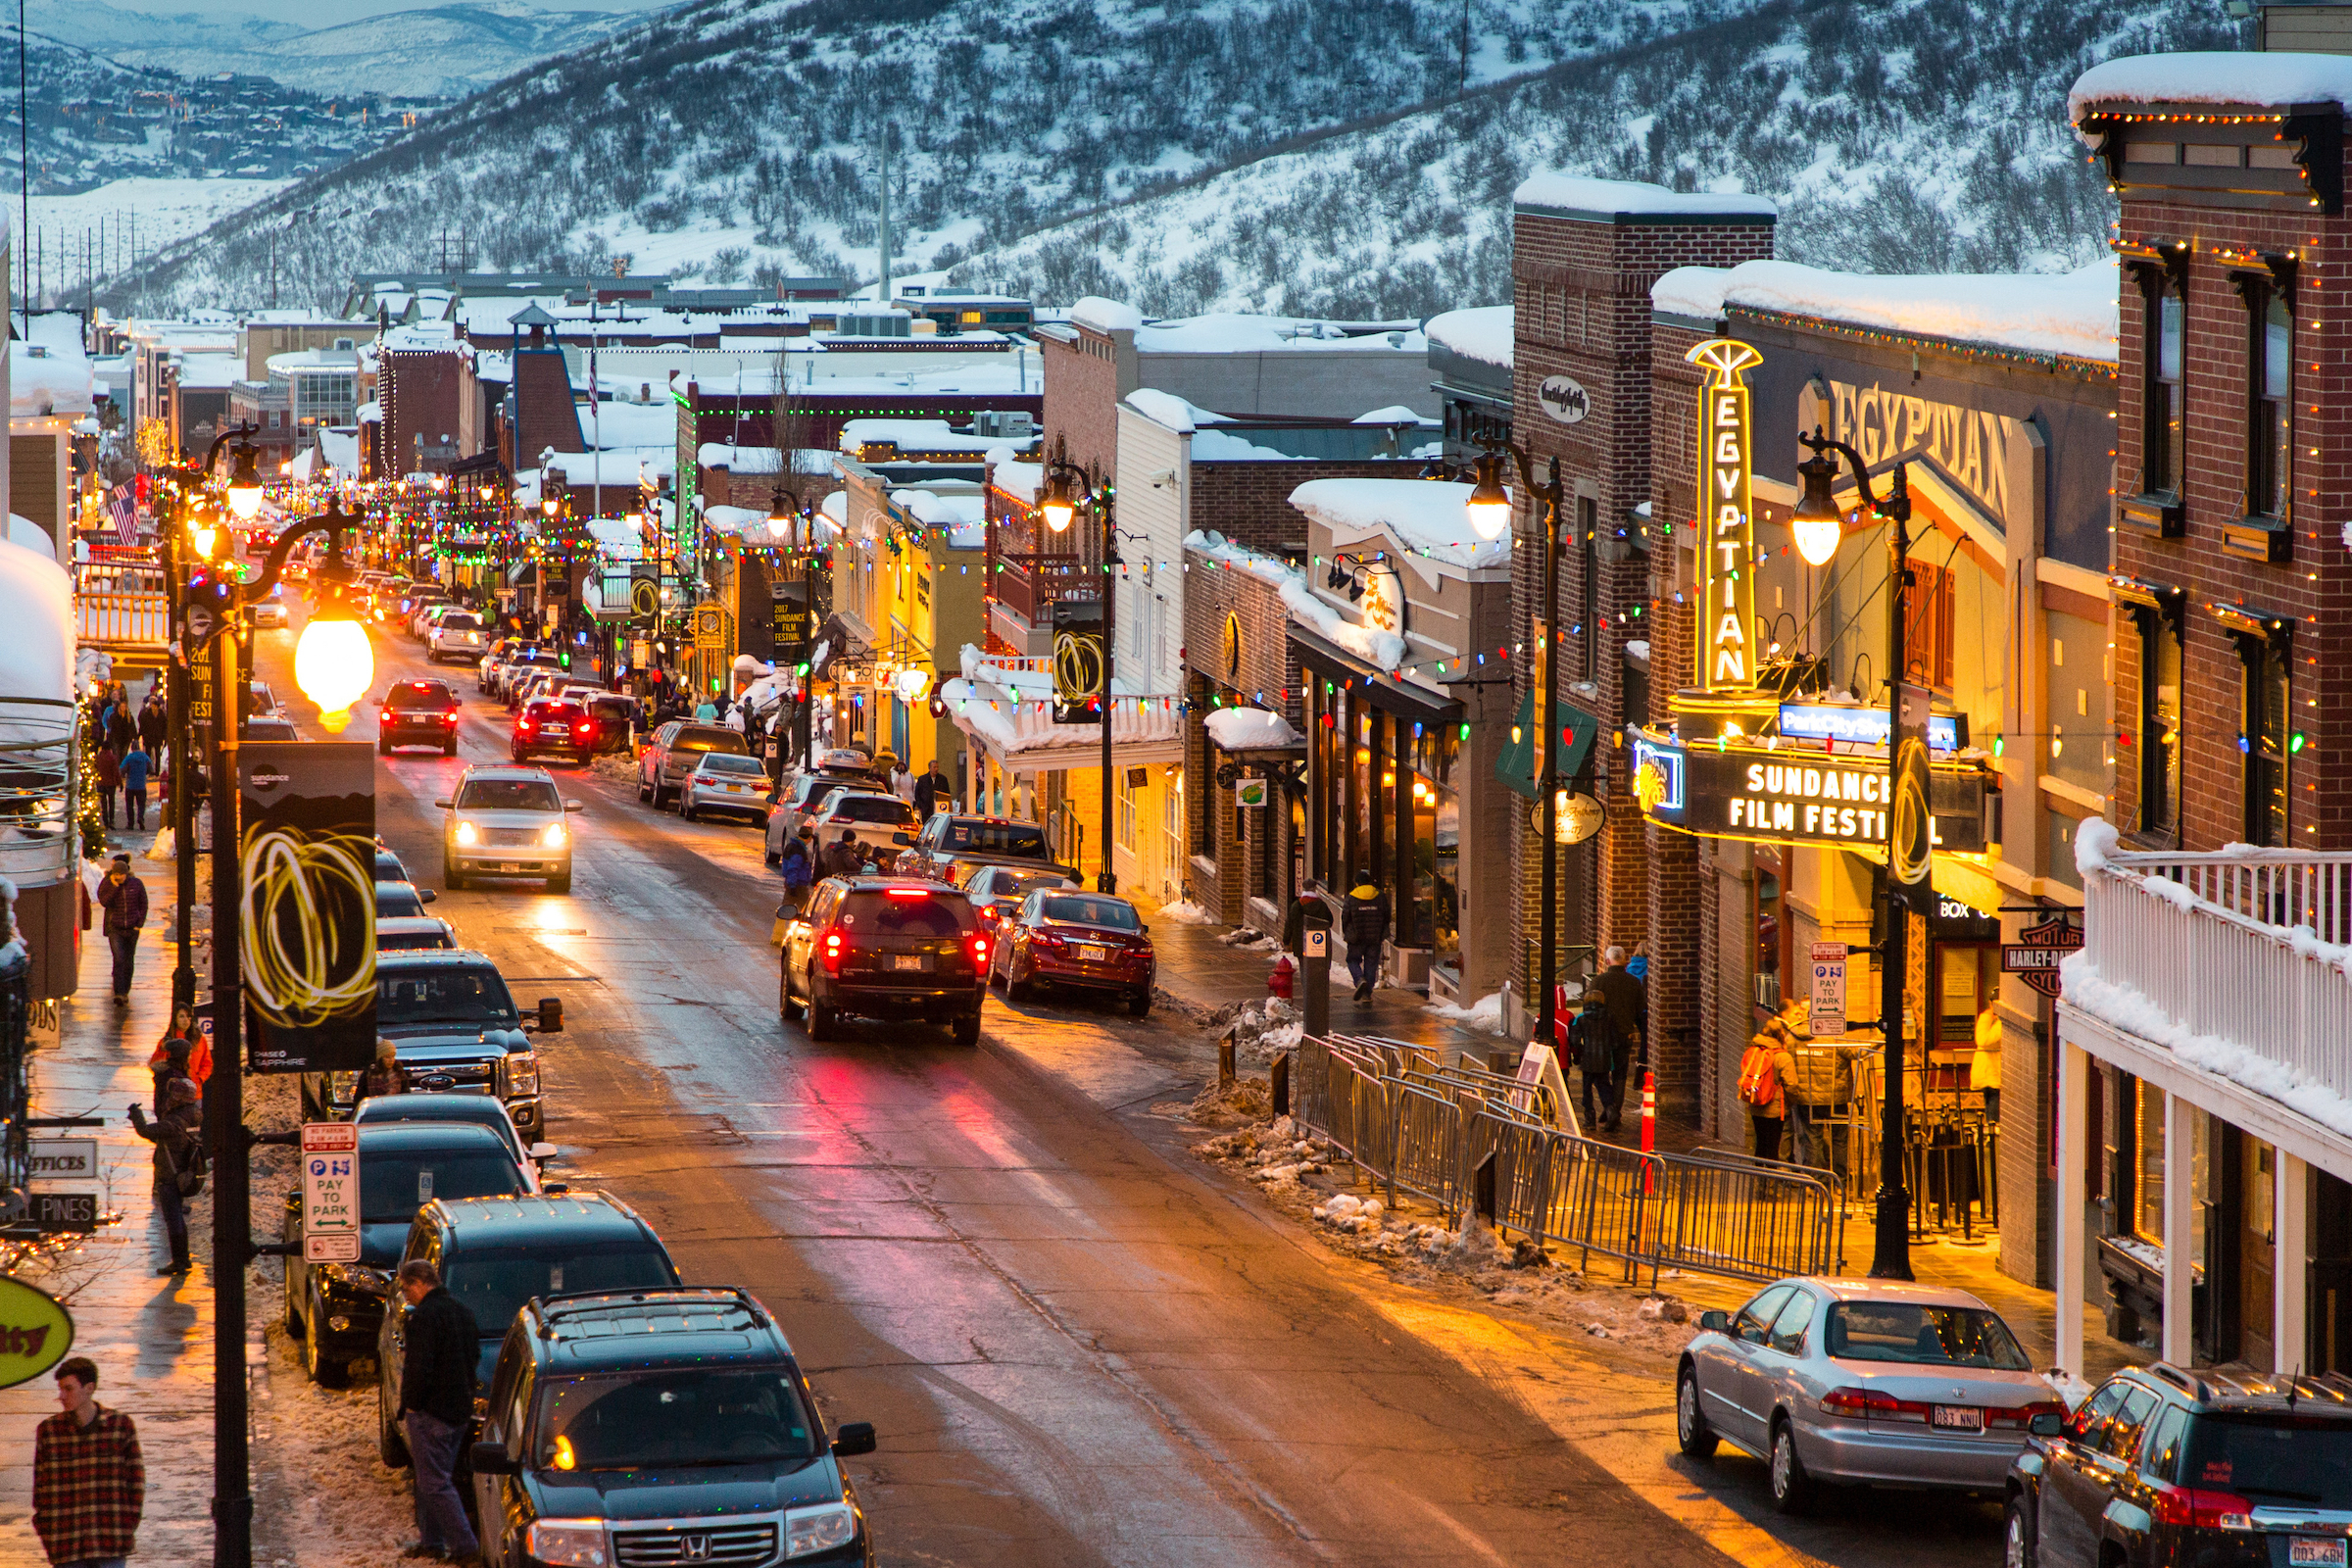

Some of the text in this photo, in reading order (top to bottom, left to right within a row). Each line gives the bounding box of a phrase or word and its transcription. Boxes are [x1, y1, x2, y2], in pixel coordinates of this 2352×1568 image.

[1830, 379, 2012, 523] EGYPTIAN
[1715, 395, 1745, 681] EGYPTIAN
[774, 613, 806, 622] SUNDANCE
[782, 623, 796, 632] FILM
[774, 632, 800, 641] FESTIVAL
[1747, 763, 1891, 803] SUNDANCE
[1730, 799, 1943, 846] FILM FESTIL
[1939, 902, 1970, 918] BOX
[1820, 979, 1837, 988] PAY
[254, 1057, 307, 1066] SAPPHIRE
[31, 1155, 86, 1171] FFICES
[317, 1180, 343, 1191] PAY
[321, 1193, 340, 1203] TO
[41, 1198, 91, 1222] PINES
[313, 1205, 349, 1216] PARK
